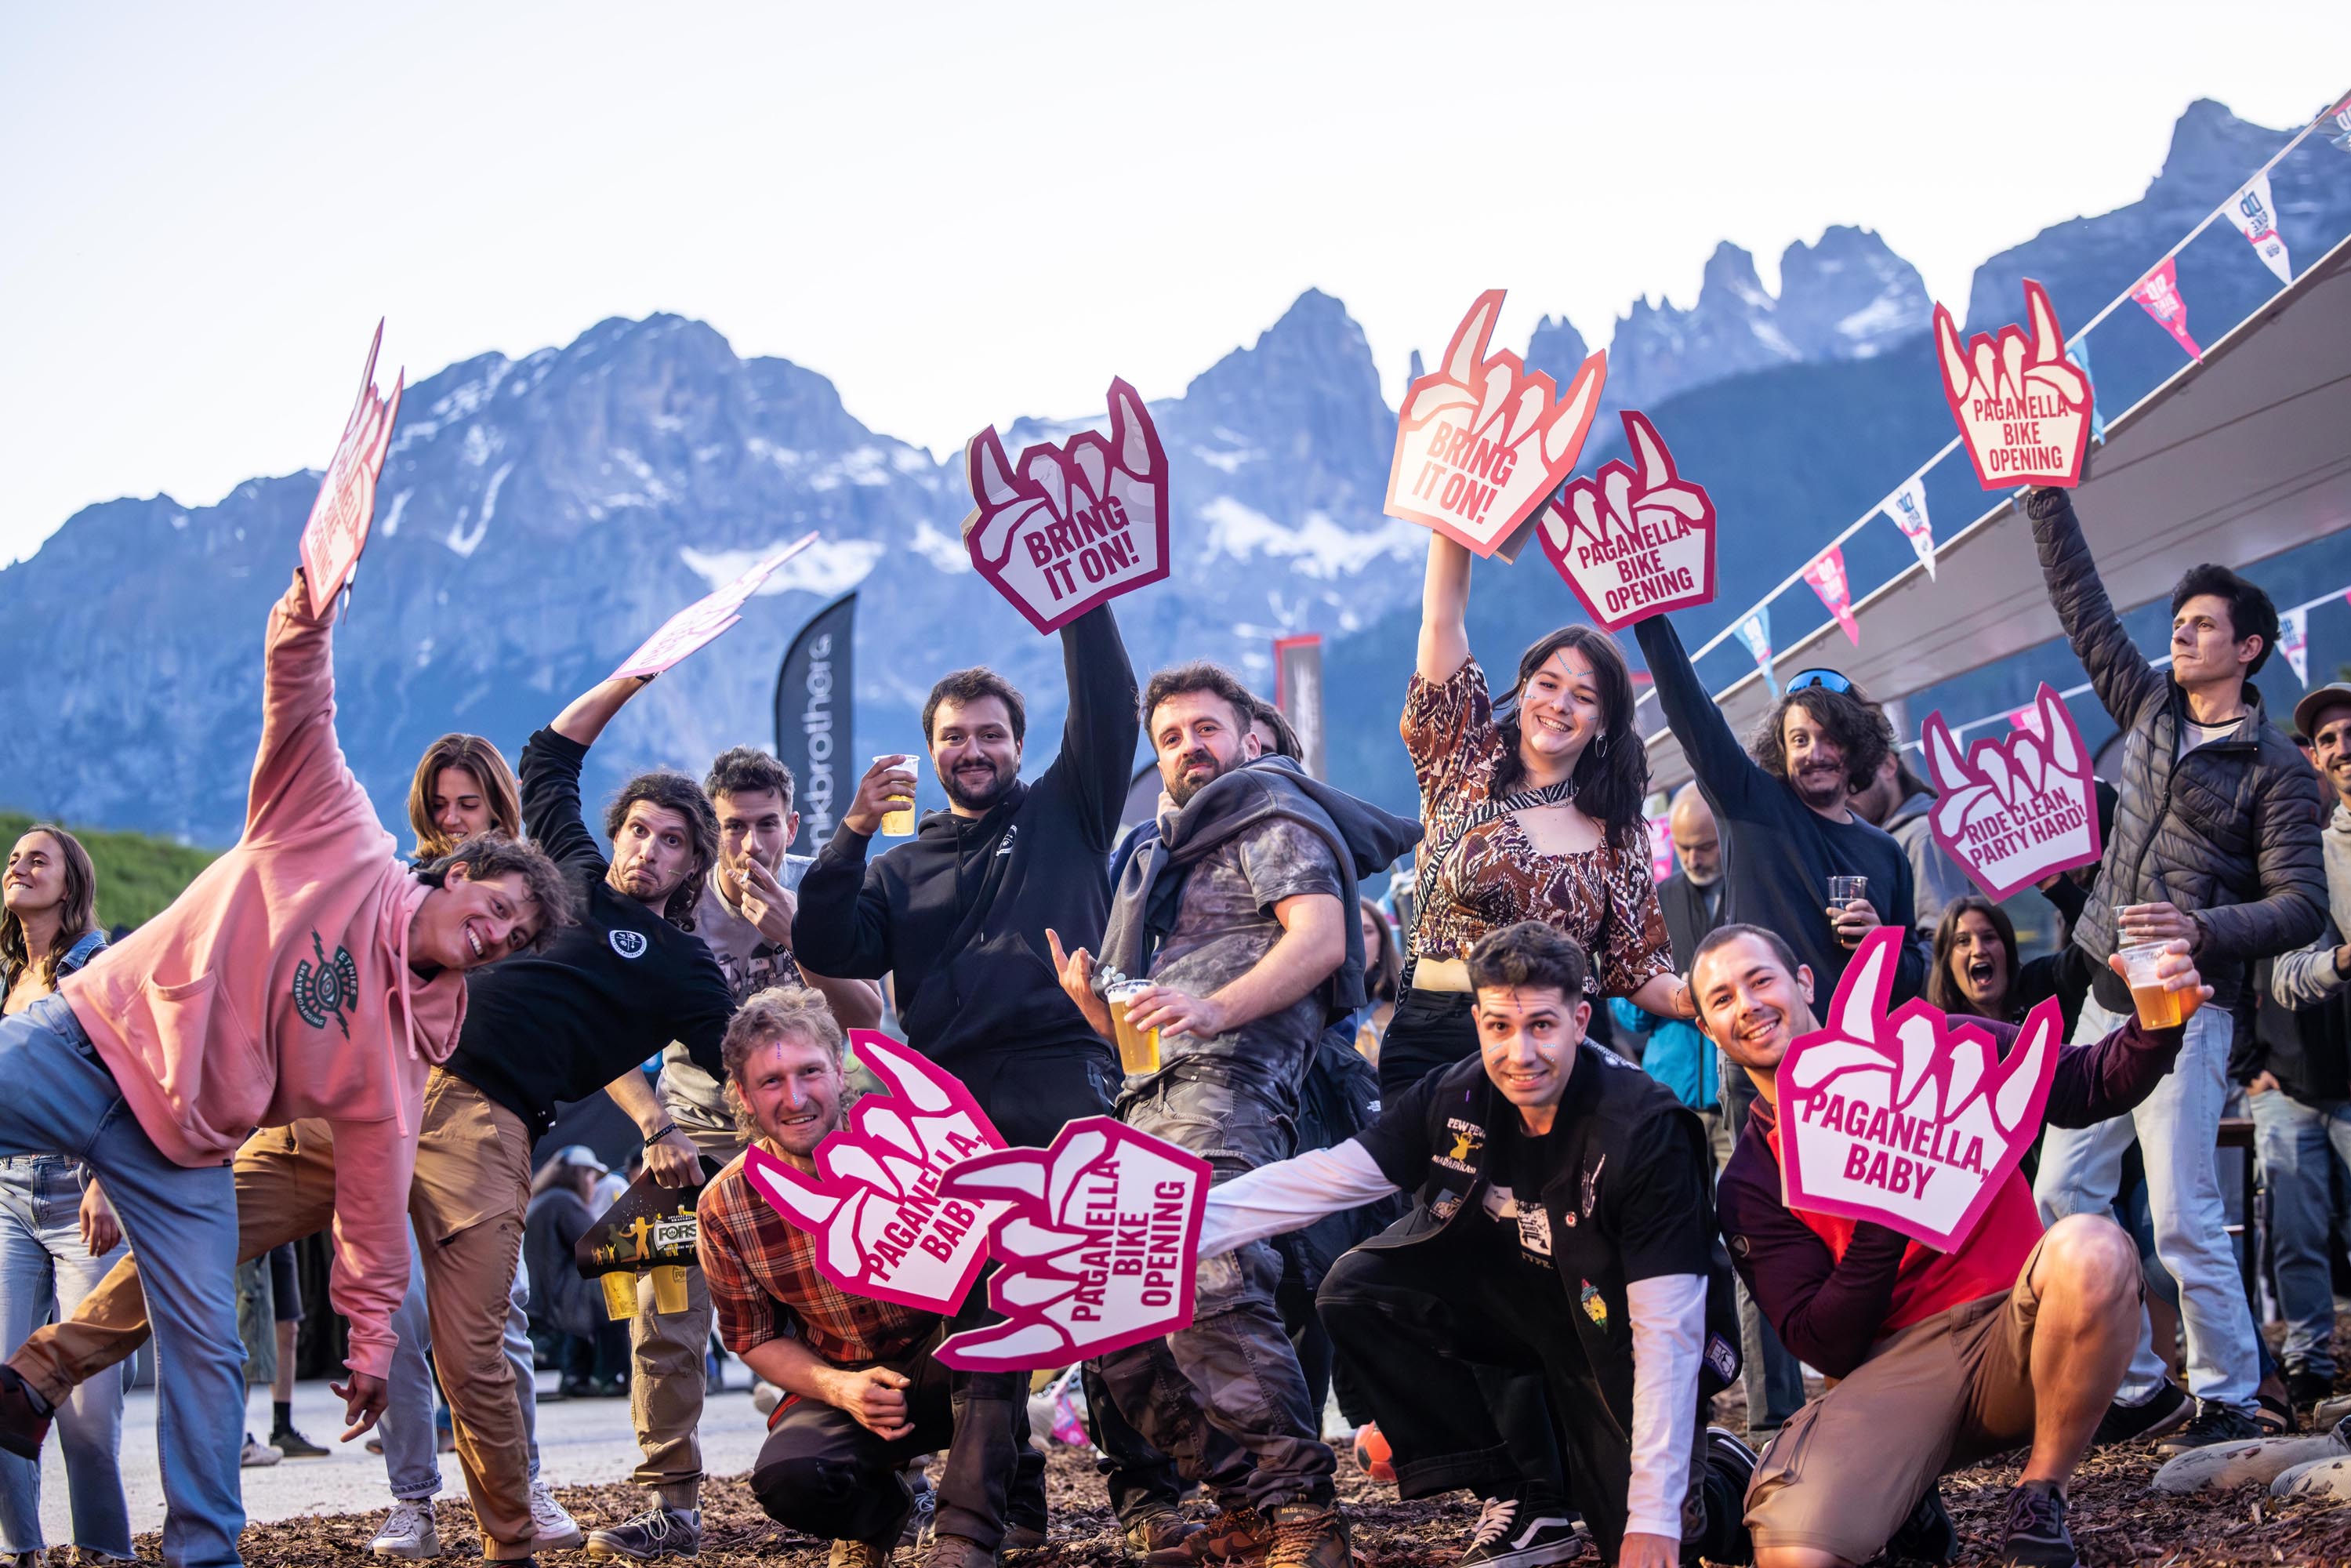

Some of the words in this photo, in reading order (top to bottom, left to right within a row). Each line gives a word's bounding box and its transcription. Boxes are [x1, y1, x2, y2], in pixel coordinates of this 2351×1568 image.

[1973, 394, 2069, 422] PAGANELLA
[2003, 422, 2041, 446] BIKE
[1426, 421, 1518, 488] BRING
[1989, 445, 2063, 472] OPENING
[1412, 459, 1447, 500] IT
[1439, 474, 1498, 525] ON!
[1023, 495, 1130, 568] BRING
[1576, 515, 1692, 569] PAGANELLA
[1043, 557, 1077, 601] IT
[1079, 530, 1141, 583] ON!
[1605, 567, 1694, 614] OPENING
[1616, 549, 1665, 584] BIKE
[1965, 811, 2012, 845] RIDE
[2010, 786, 2077, 827] CLEAN,
[1968, 828, 2030, 869] PARTY
[2029, 804, 2088, 844] HARD!
[294, 964, 325, 1025] SKATEBOARDING
[338, 951, 357, 996] ETNIES
[1446, 1117, 1470, 1132] PEW
[1801, 1090, 1990, 1182] PAGANELLA,
[1843, 1142, 1936, 1201] BABY
[1070, 1160, 1120, 1322] PAGANELLA
[1112, 1212, 1149, 1276] BIKE
[1140, 1181, 1186, 1307] OPENING
